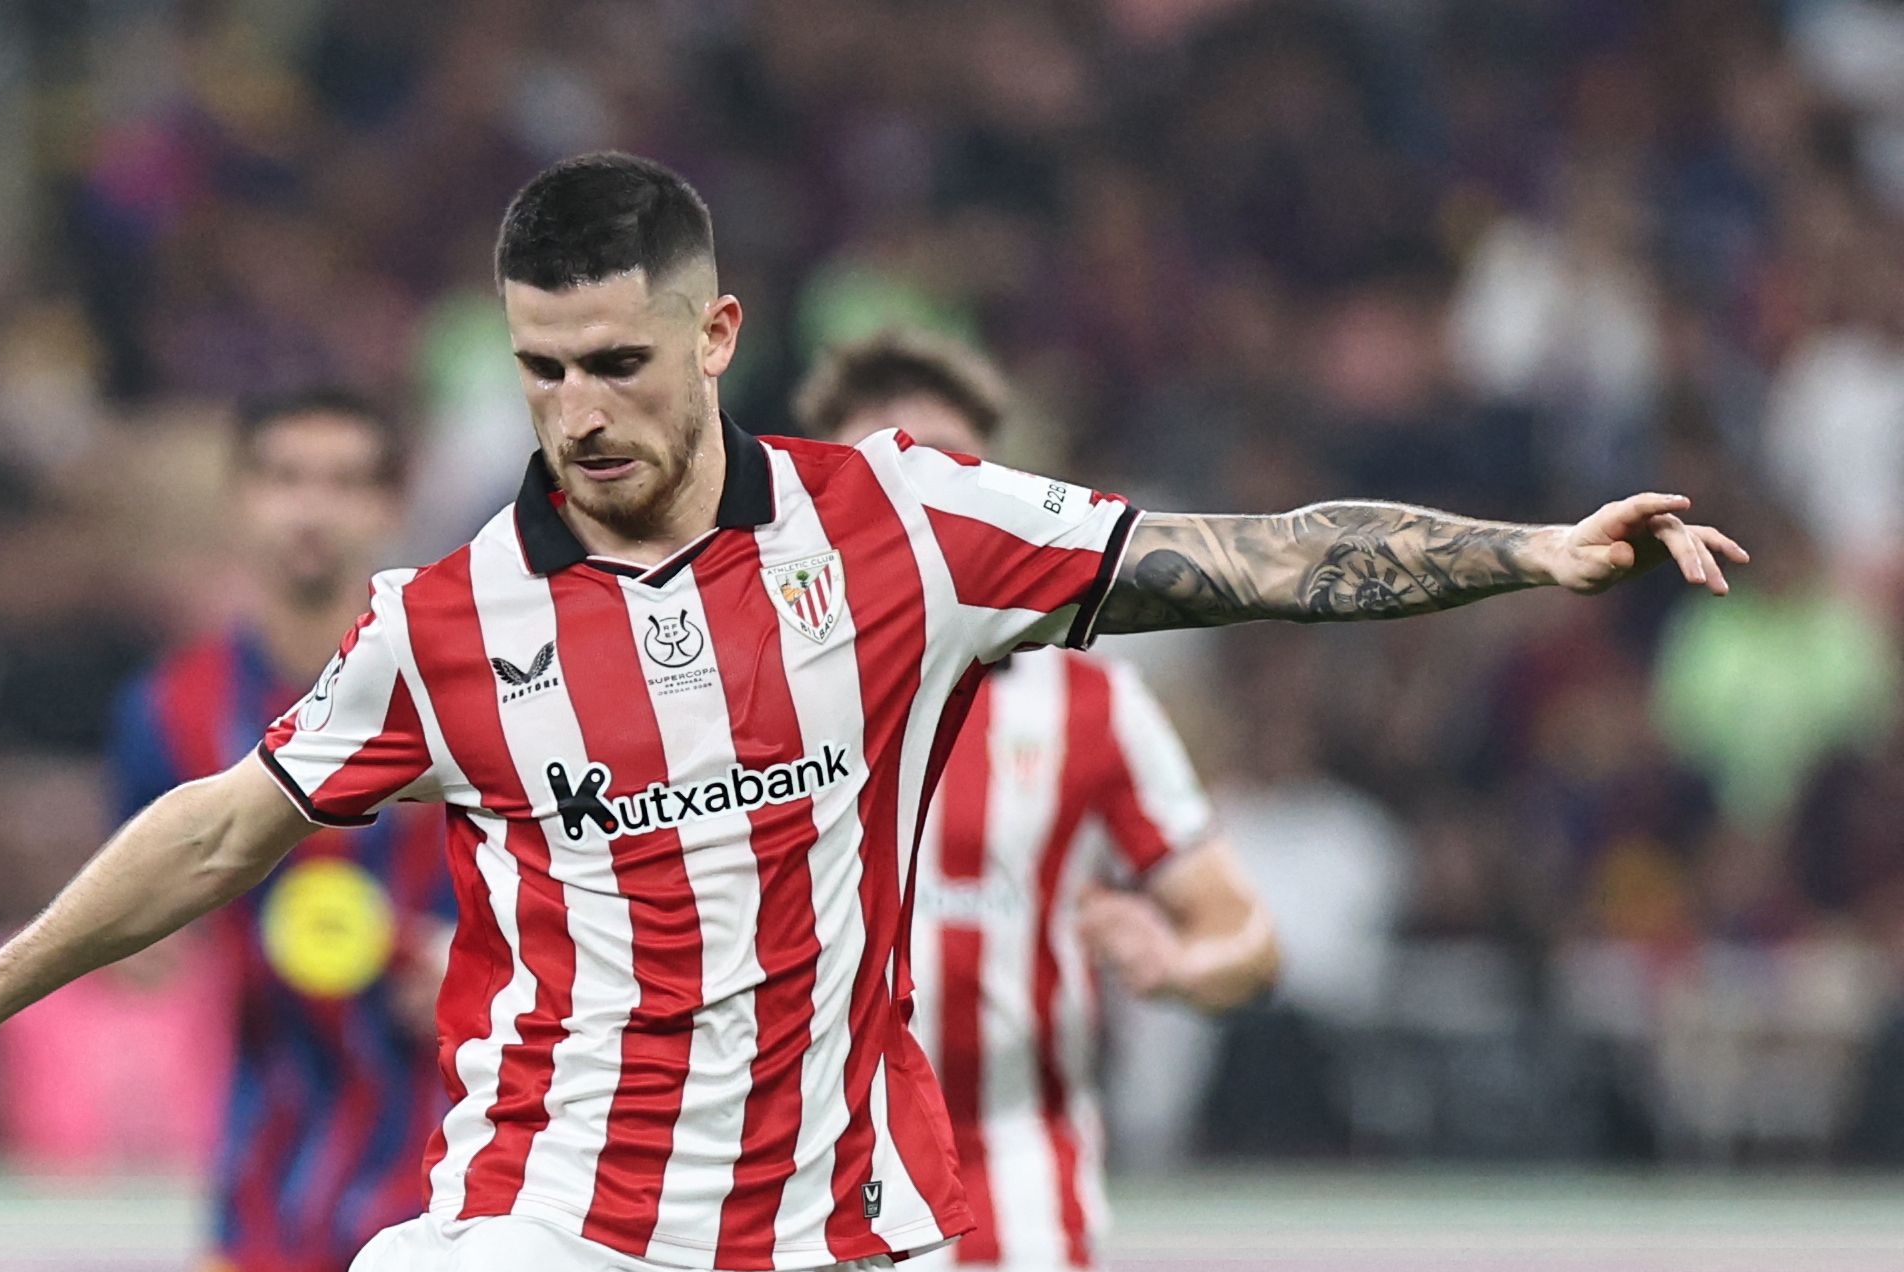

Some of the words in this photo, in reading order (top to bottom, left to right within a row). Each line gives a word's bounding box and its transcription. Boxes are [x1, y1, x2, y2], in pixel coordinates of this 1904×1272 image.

[767, 560, 808, 576] ATHLETIC
[810, 554, 835, 566] CLUB
[799, 613, 834, 640] BILBAO
[647, 666, 717, 686] SUPERCOPA
[502, 677, 559, 704] CASTORE
[546, 744, 850, 841] Kutxabank
